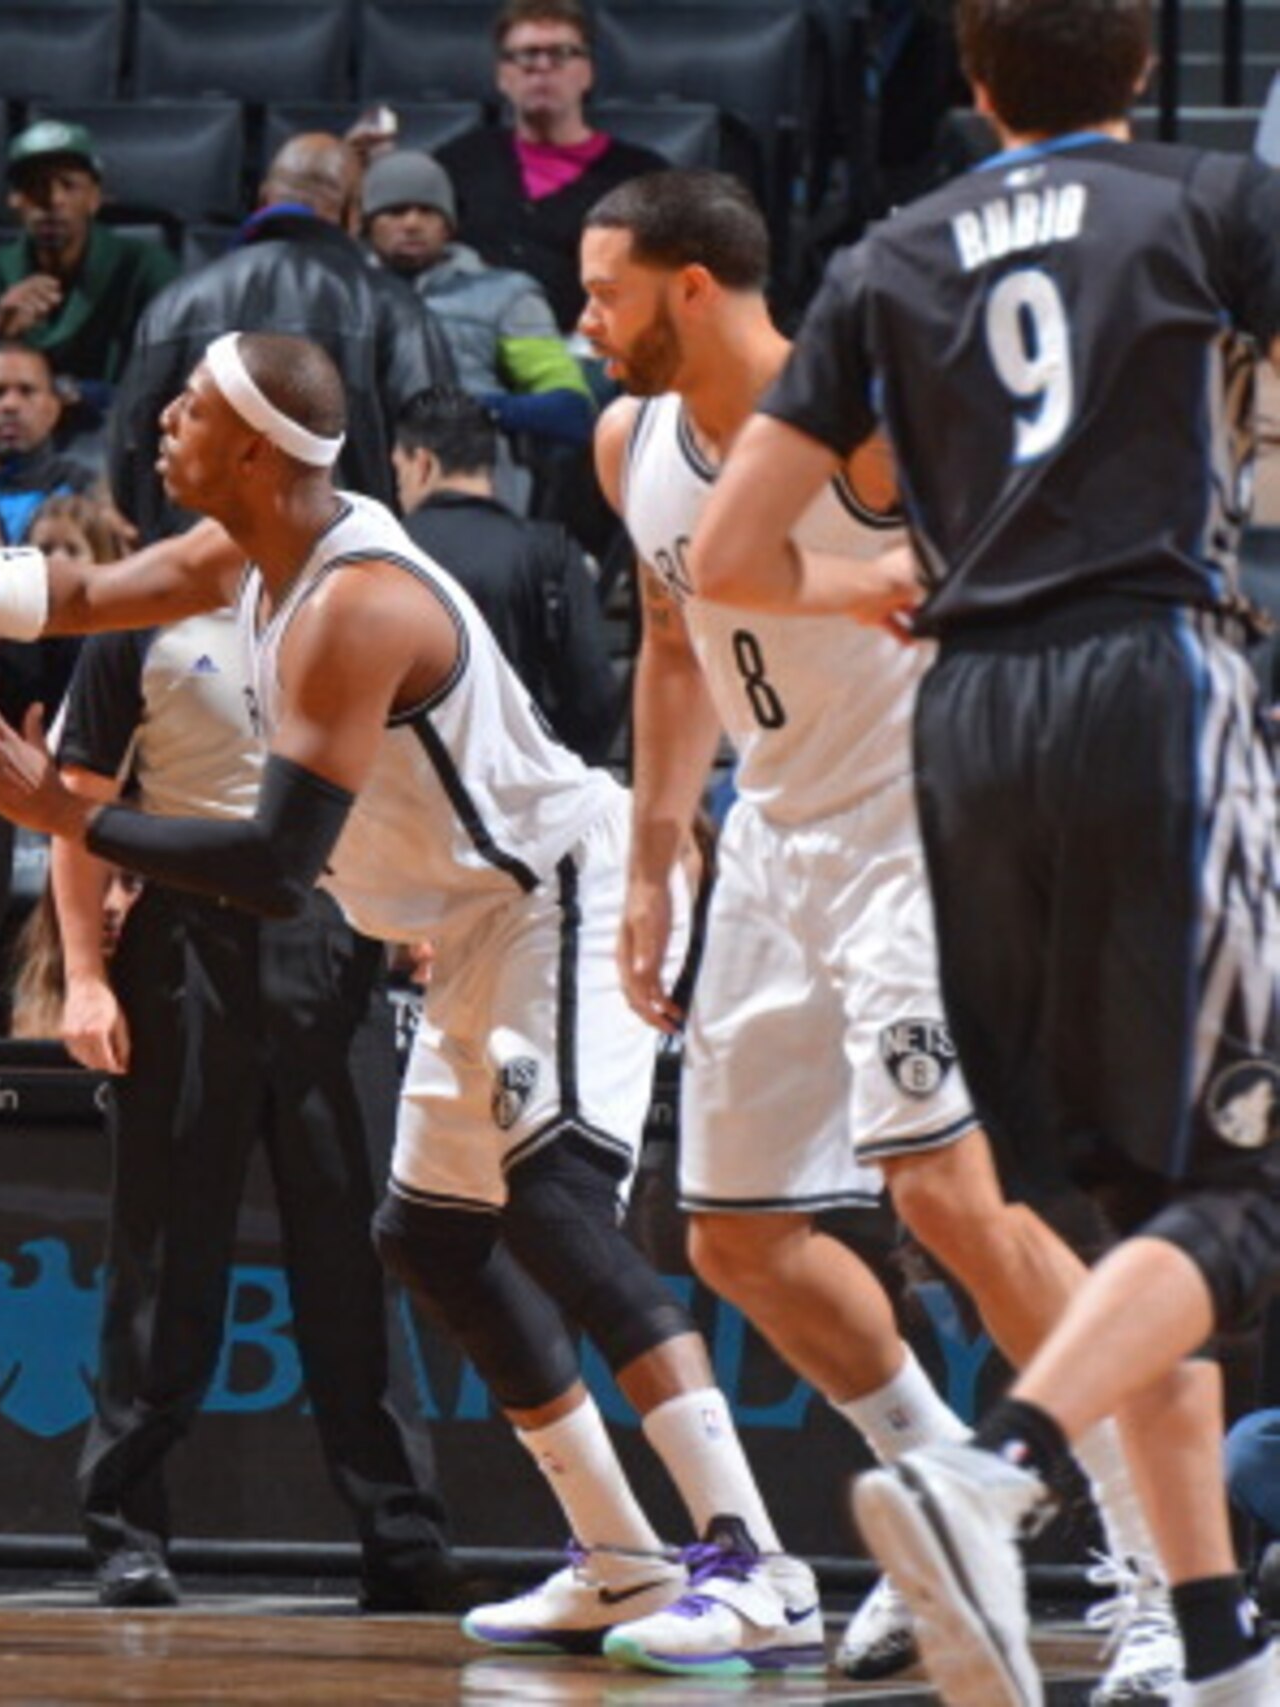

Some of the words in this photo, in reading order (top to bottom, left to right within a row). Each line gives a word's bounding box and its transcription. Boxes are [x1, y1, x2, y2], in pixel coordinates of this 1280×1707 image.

[953, 183, 1086, 272] RUBIO
[985, 268, 1074, 464] 9
[732, 628, 786, 729] 8
